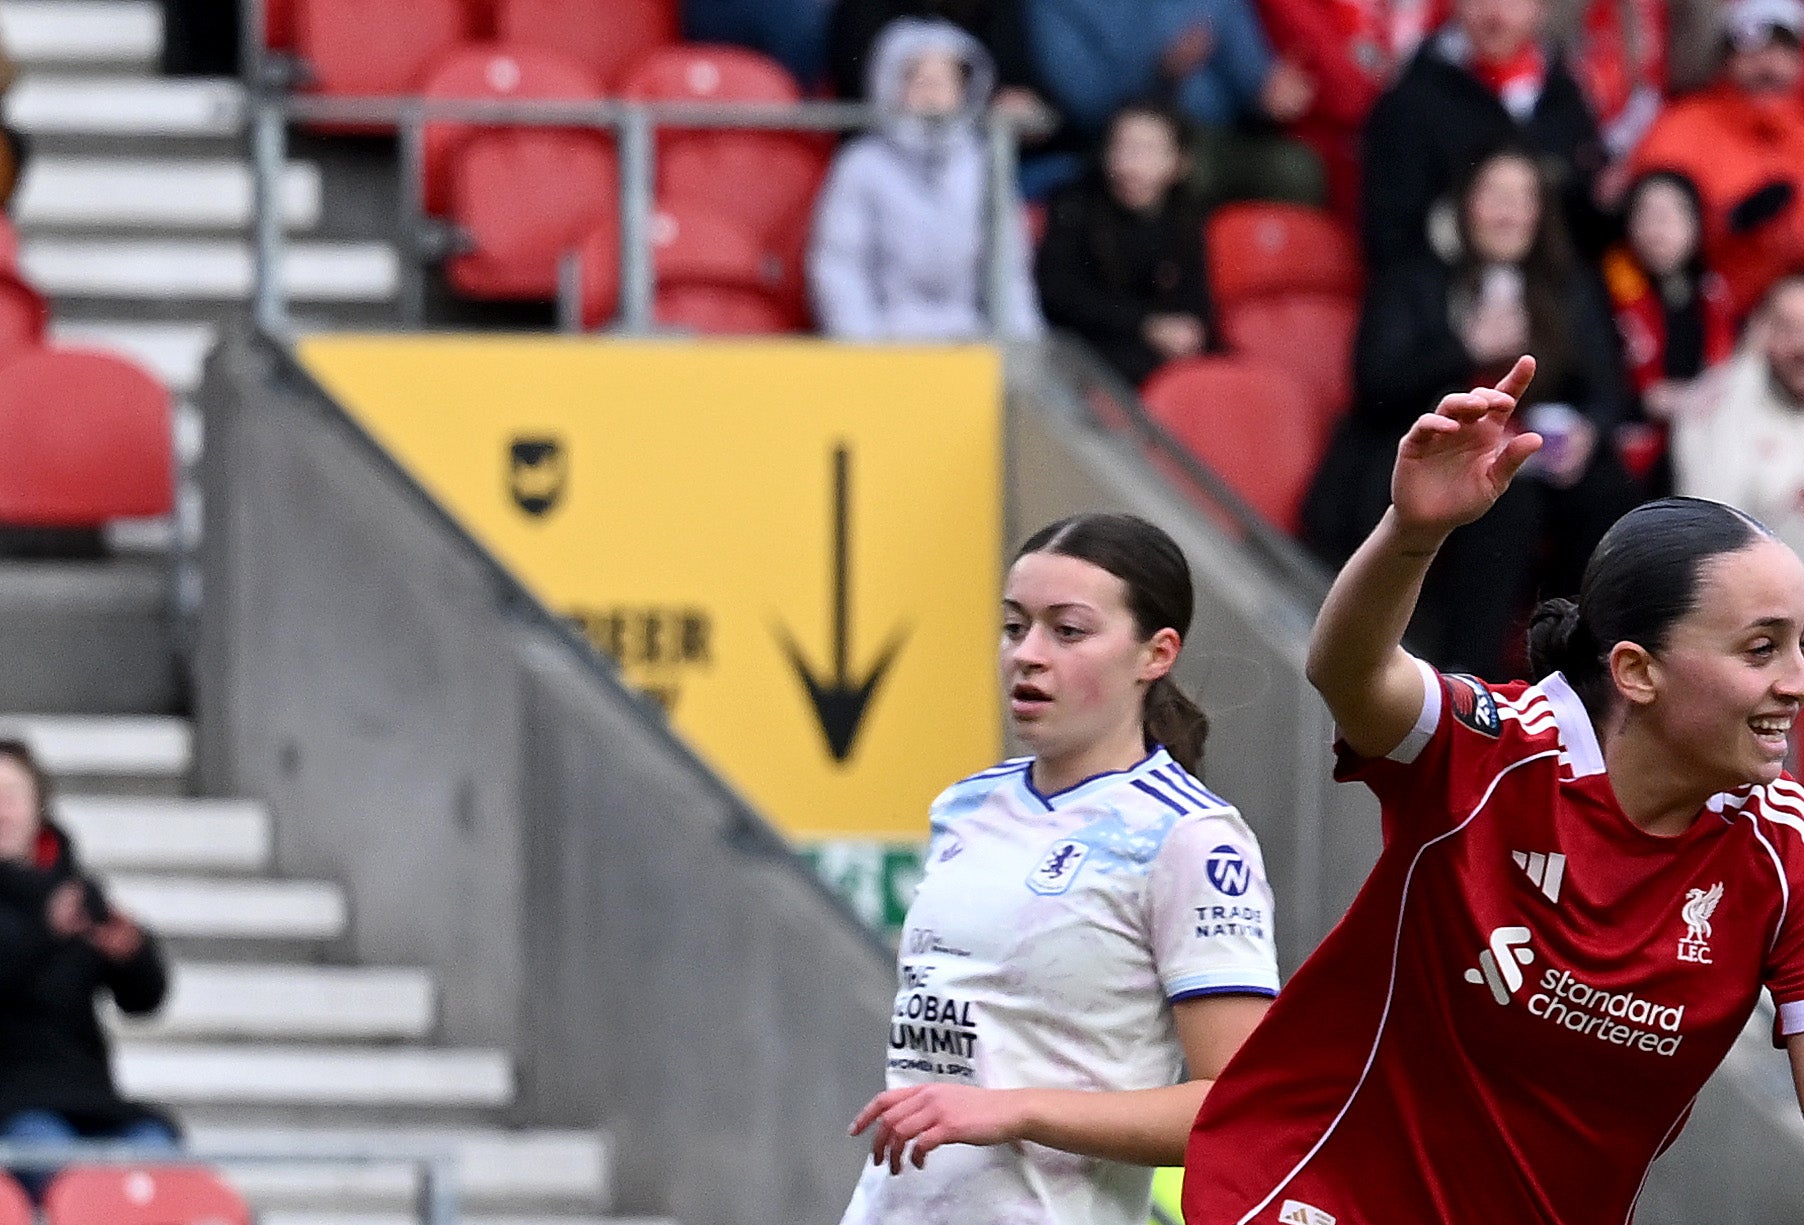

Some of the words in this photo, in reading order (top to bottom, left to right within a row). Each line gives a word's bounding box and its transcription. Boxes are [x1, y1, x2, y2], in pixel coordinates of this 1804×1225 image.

[1195, 906, 1261, 923] TRADE
[1527, 993, 1684, 1057] chartered
[1540, 968, 1685, 1032] standard
[889, 1023, 977, 1059] UMMIT
